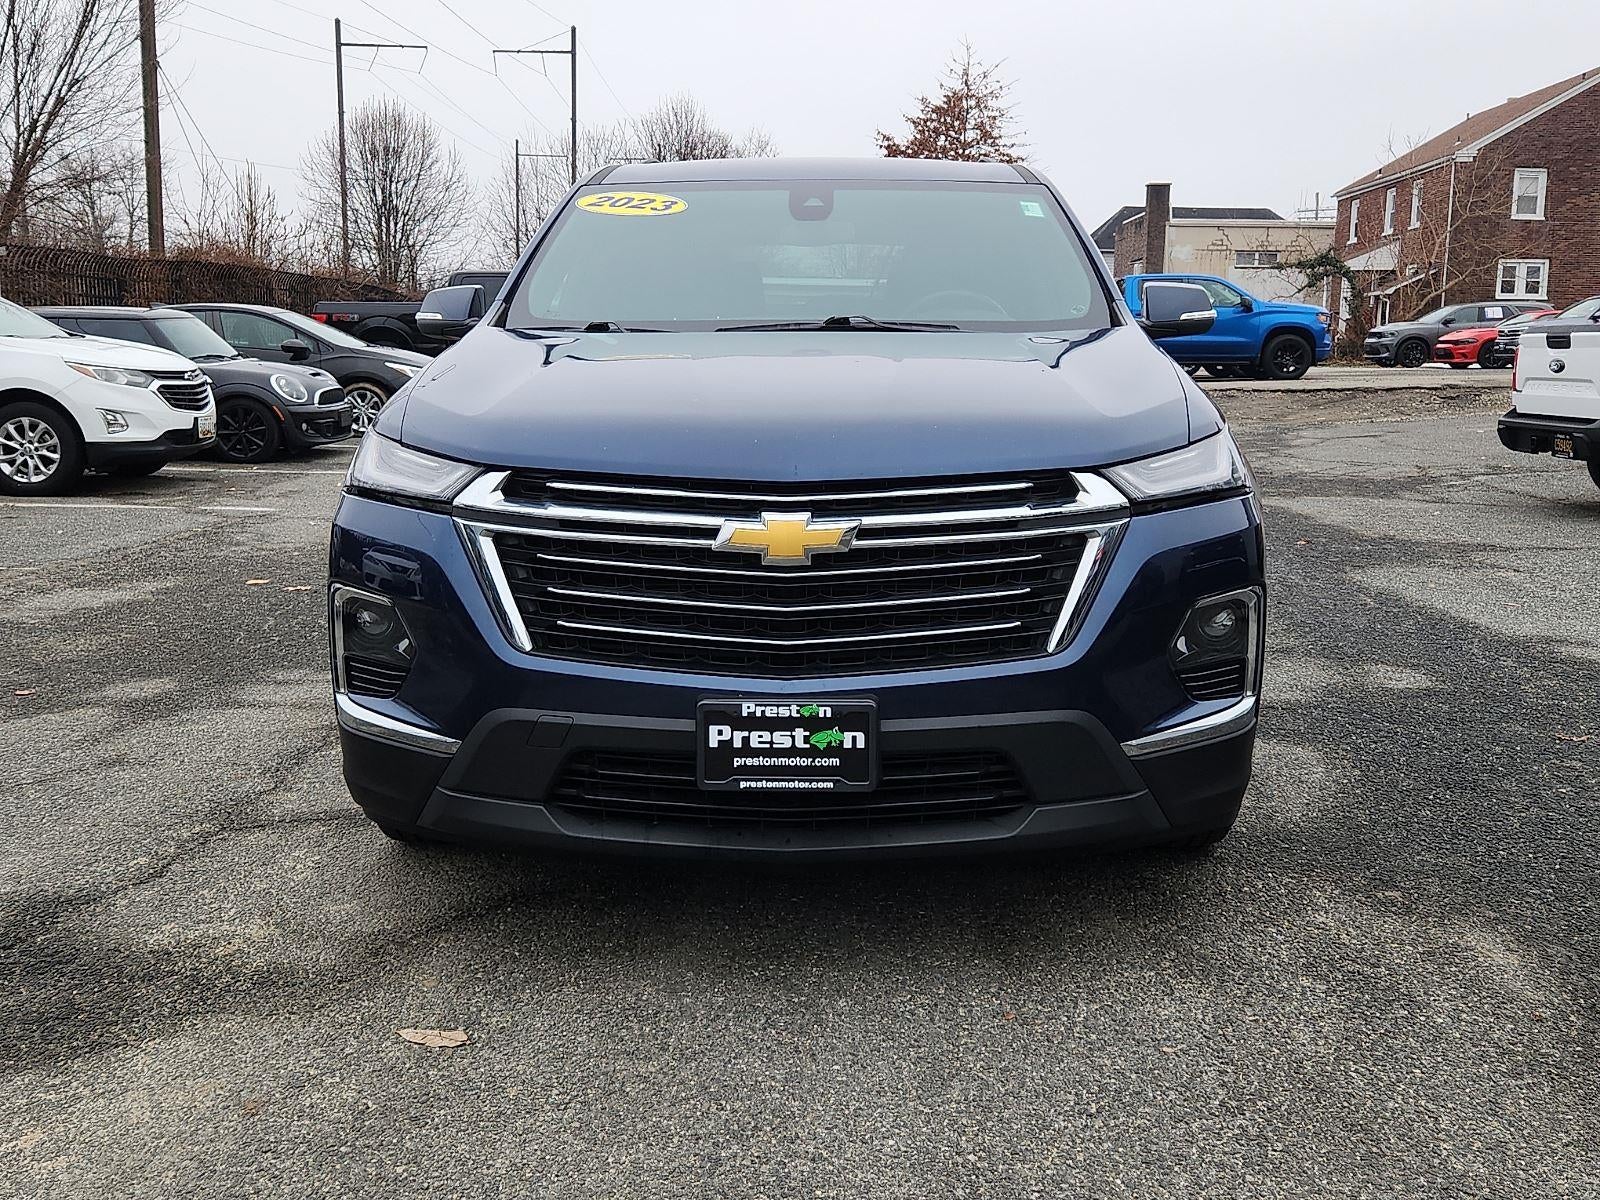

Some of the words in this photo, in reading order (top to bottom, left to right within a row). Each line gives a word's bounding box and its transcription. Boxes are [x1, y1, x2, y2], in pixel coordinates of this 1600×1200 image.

[584, 196, 679, 211] 2023
[733, 756, 840, 767] prestonmotor.com
[739, 780, 834, 789] prestonmotor.com
